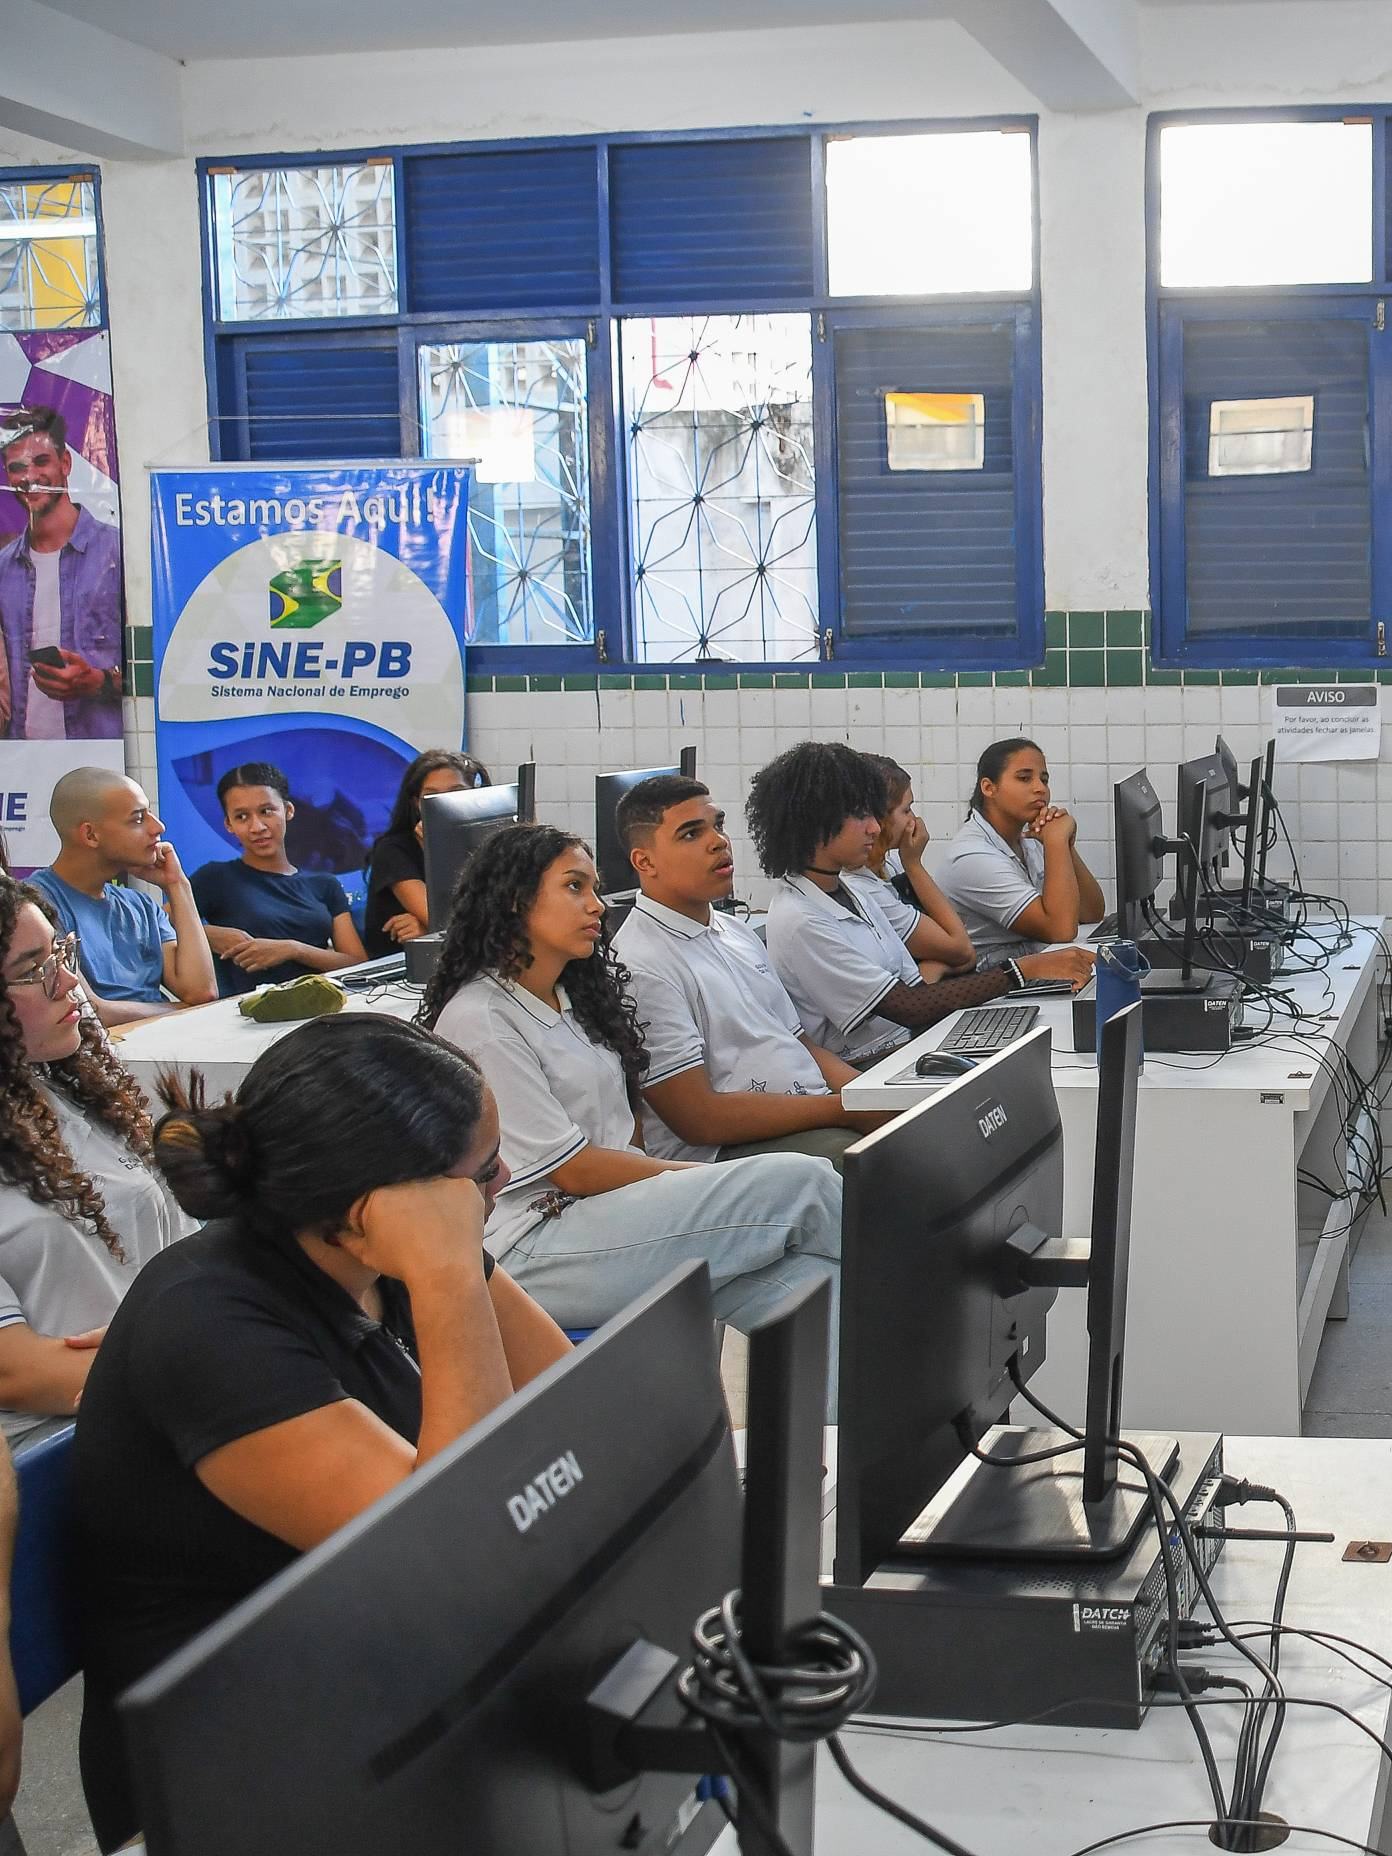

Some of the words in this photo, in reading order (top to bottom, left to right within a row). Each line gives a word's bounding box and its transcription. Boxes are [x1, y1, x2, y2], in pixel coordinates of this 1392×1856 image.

[175, 492, 324, 527] Estamos
[211, 685, 263, 698] Sistema
[267, 685, 326, 698] Nacional
[329, 685, 346, 698] de
[349, 685, 410, 700] Emprego
[1306, 691, 1345, 703] AVISO
[979, 1104, 1007, 1138] DATEN
[506, 1449, 584, 1534] DATEN
